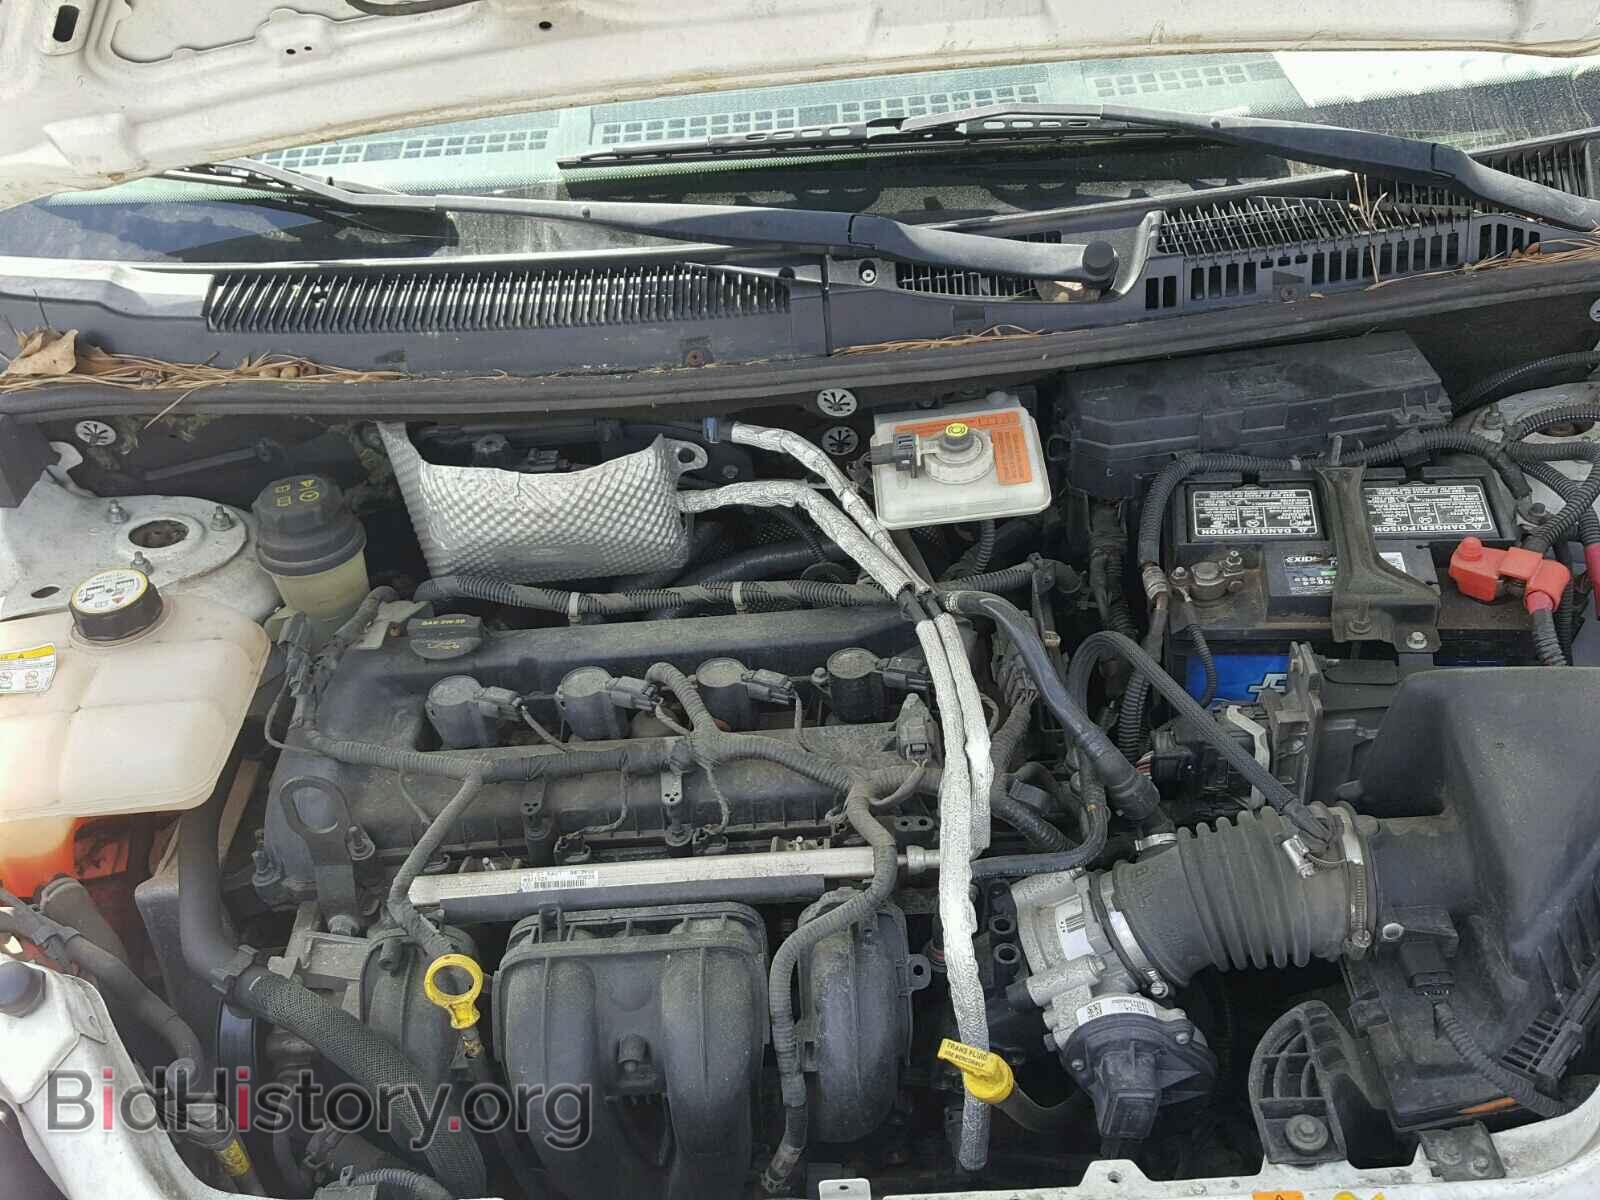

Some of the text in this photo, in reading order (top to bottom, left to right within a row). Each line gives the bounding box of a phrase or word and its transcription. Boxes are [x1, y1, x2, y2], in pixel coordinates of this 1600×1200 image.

[1200, 527, 1292, 536] DANGER/POISON
[1374, 523, 1467, 532] DANGER/POISON
[946, 1042, 988, 1060] TRANS FLUID
